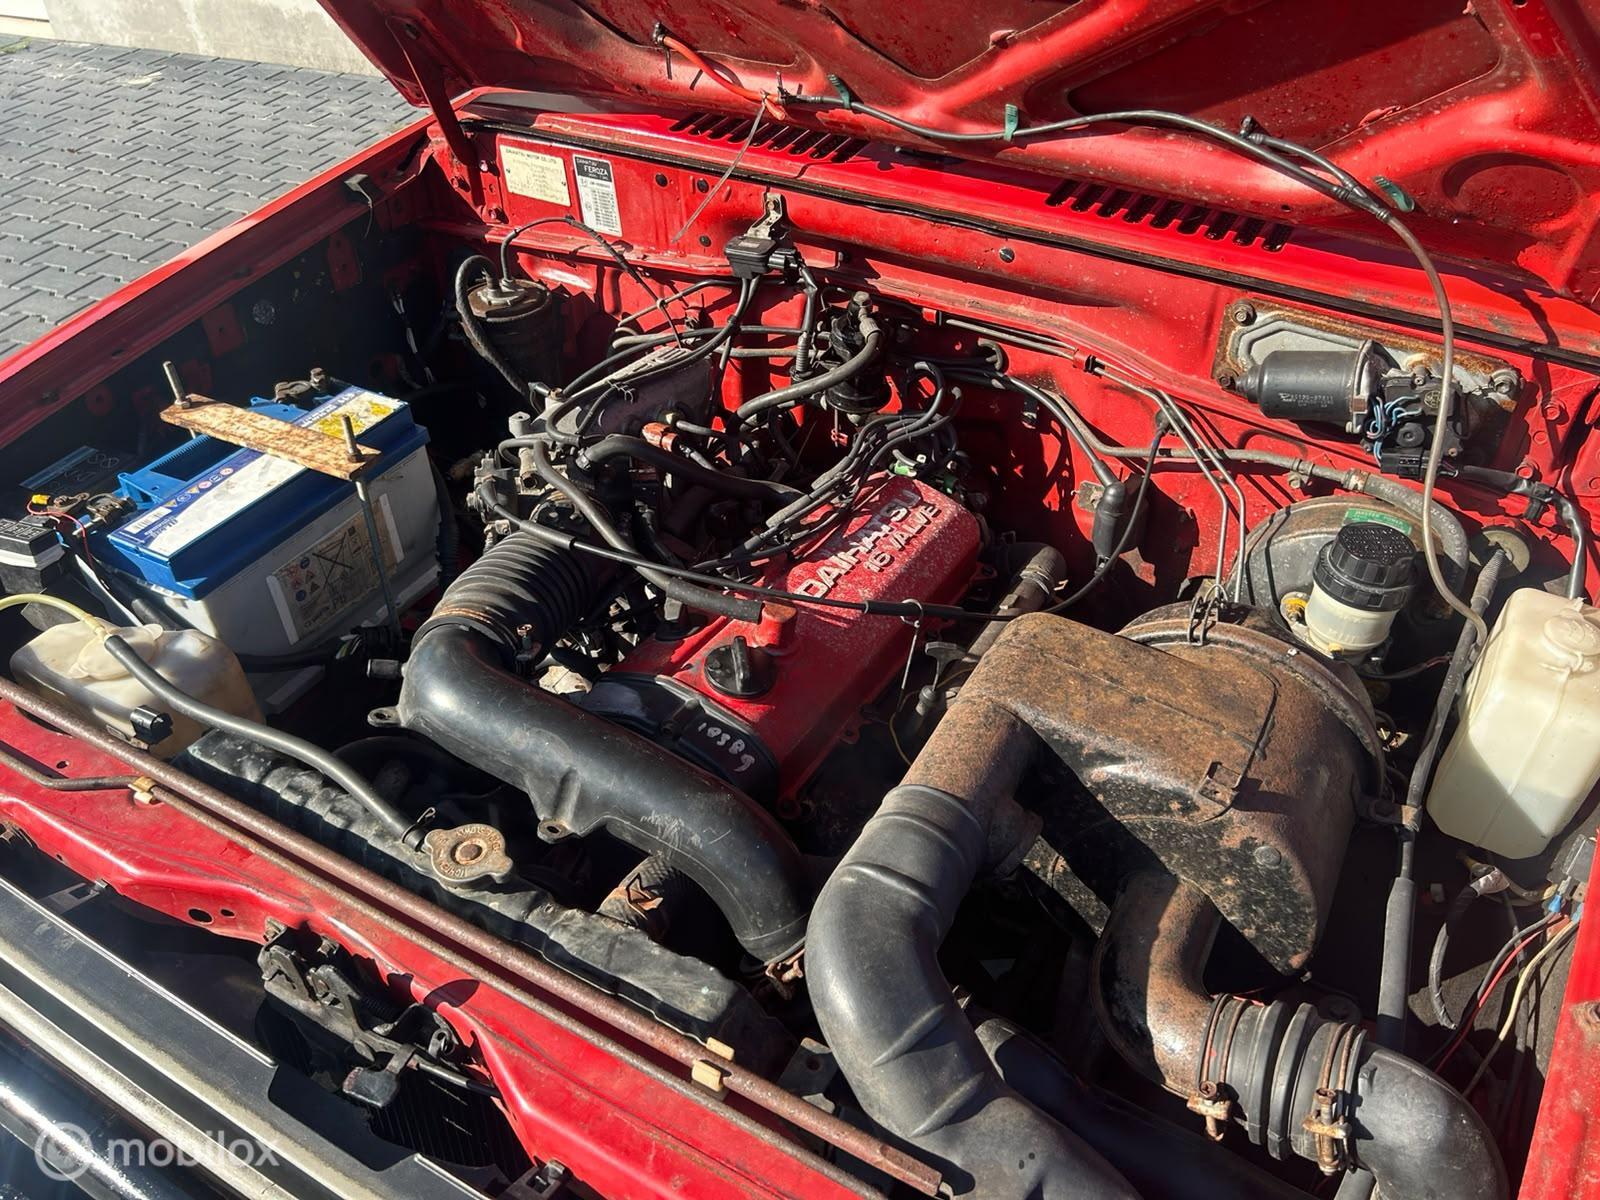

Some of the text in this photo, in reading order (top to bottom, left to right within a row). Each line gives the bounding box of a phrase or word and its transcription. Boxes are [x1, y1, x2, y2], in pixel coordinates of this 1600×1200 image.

[584, 165, 608, 175] FEROZA
[793, 489, 921, 598] DAIHATSU
[863, 503, 940, 571] 16 VALVE
